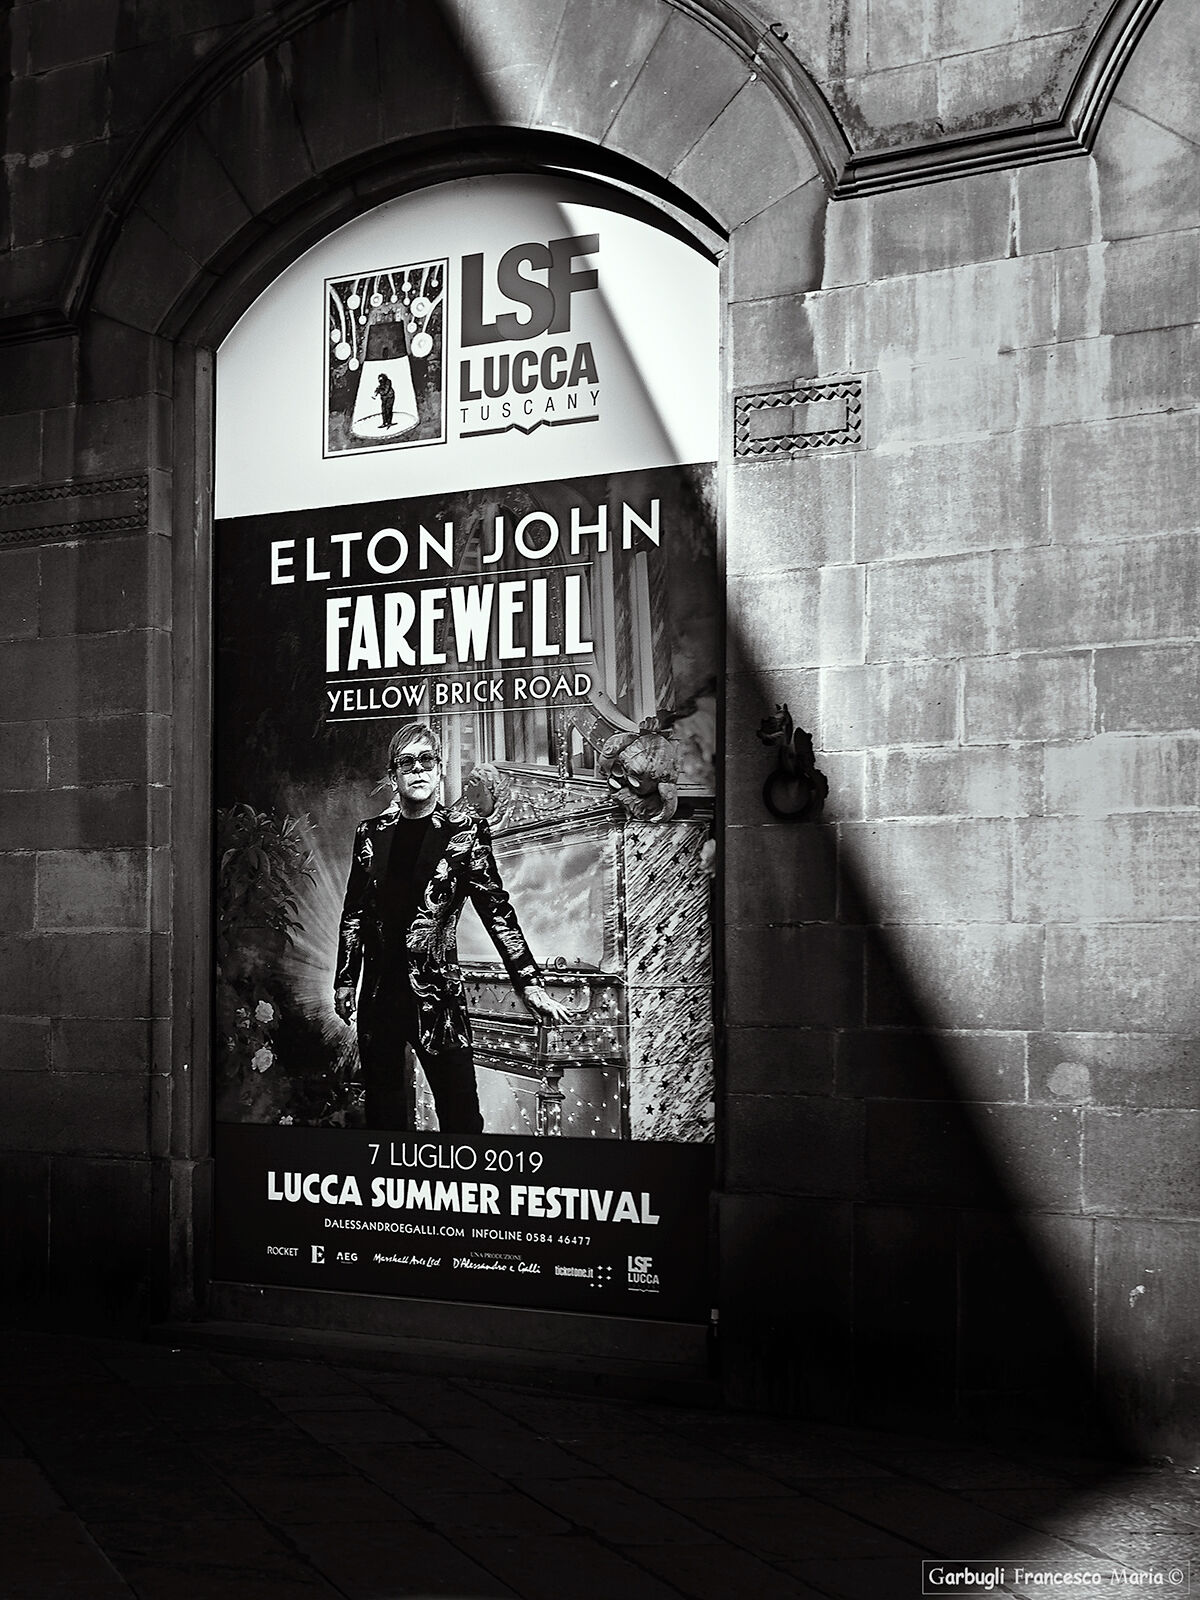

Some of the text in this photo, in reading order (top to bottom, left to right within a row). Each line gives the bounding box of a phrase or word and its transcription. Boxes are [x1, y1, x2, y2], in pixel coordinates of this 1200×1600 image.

[460, 233, 599, 347] LSF
[460, 342, 599, 401] LUCCA
[460, 390, 600, 423] TUSCANY
[270, 499, 660, 585] ELTON JOHN
[326, 576, 593, 672] FAREWELL
[327, 673, 591, 713] YELLOW BRICK ROAD
[368, 1144, 543, 1173] 7 LUGLIO 2019
[268, 1171, 660, 1225] LUCCA SUMMER FESTIVAL
[324, 1218, 592, 1245] DALESSANDROEGALLI.COM INFOLINE 0584 46477
[267, 1246, 299, 1257] ROCKET
[627, 1256, 652, 1273] LSF
[627, 1273, 660, 1285] LUCCA
